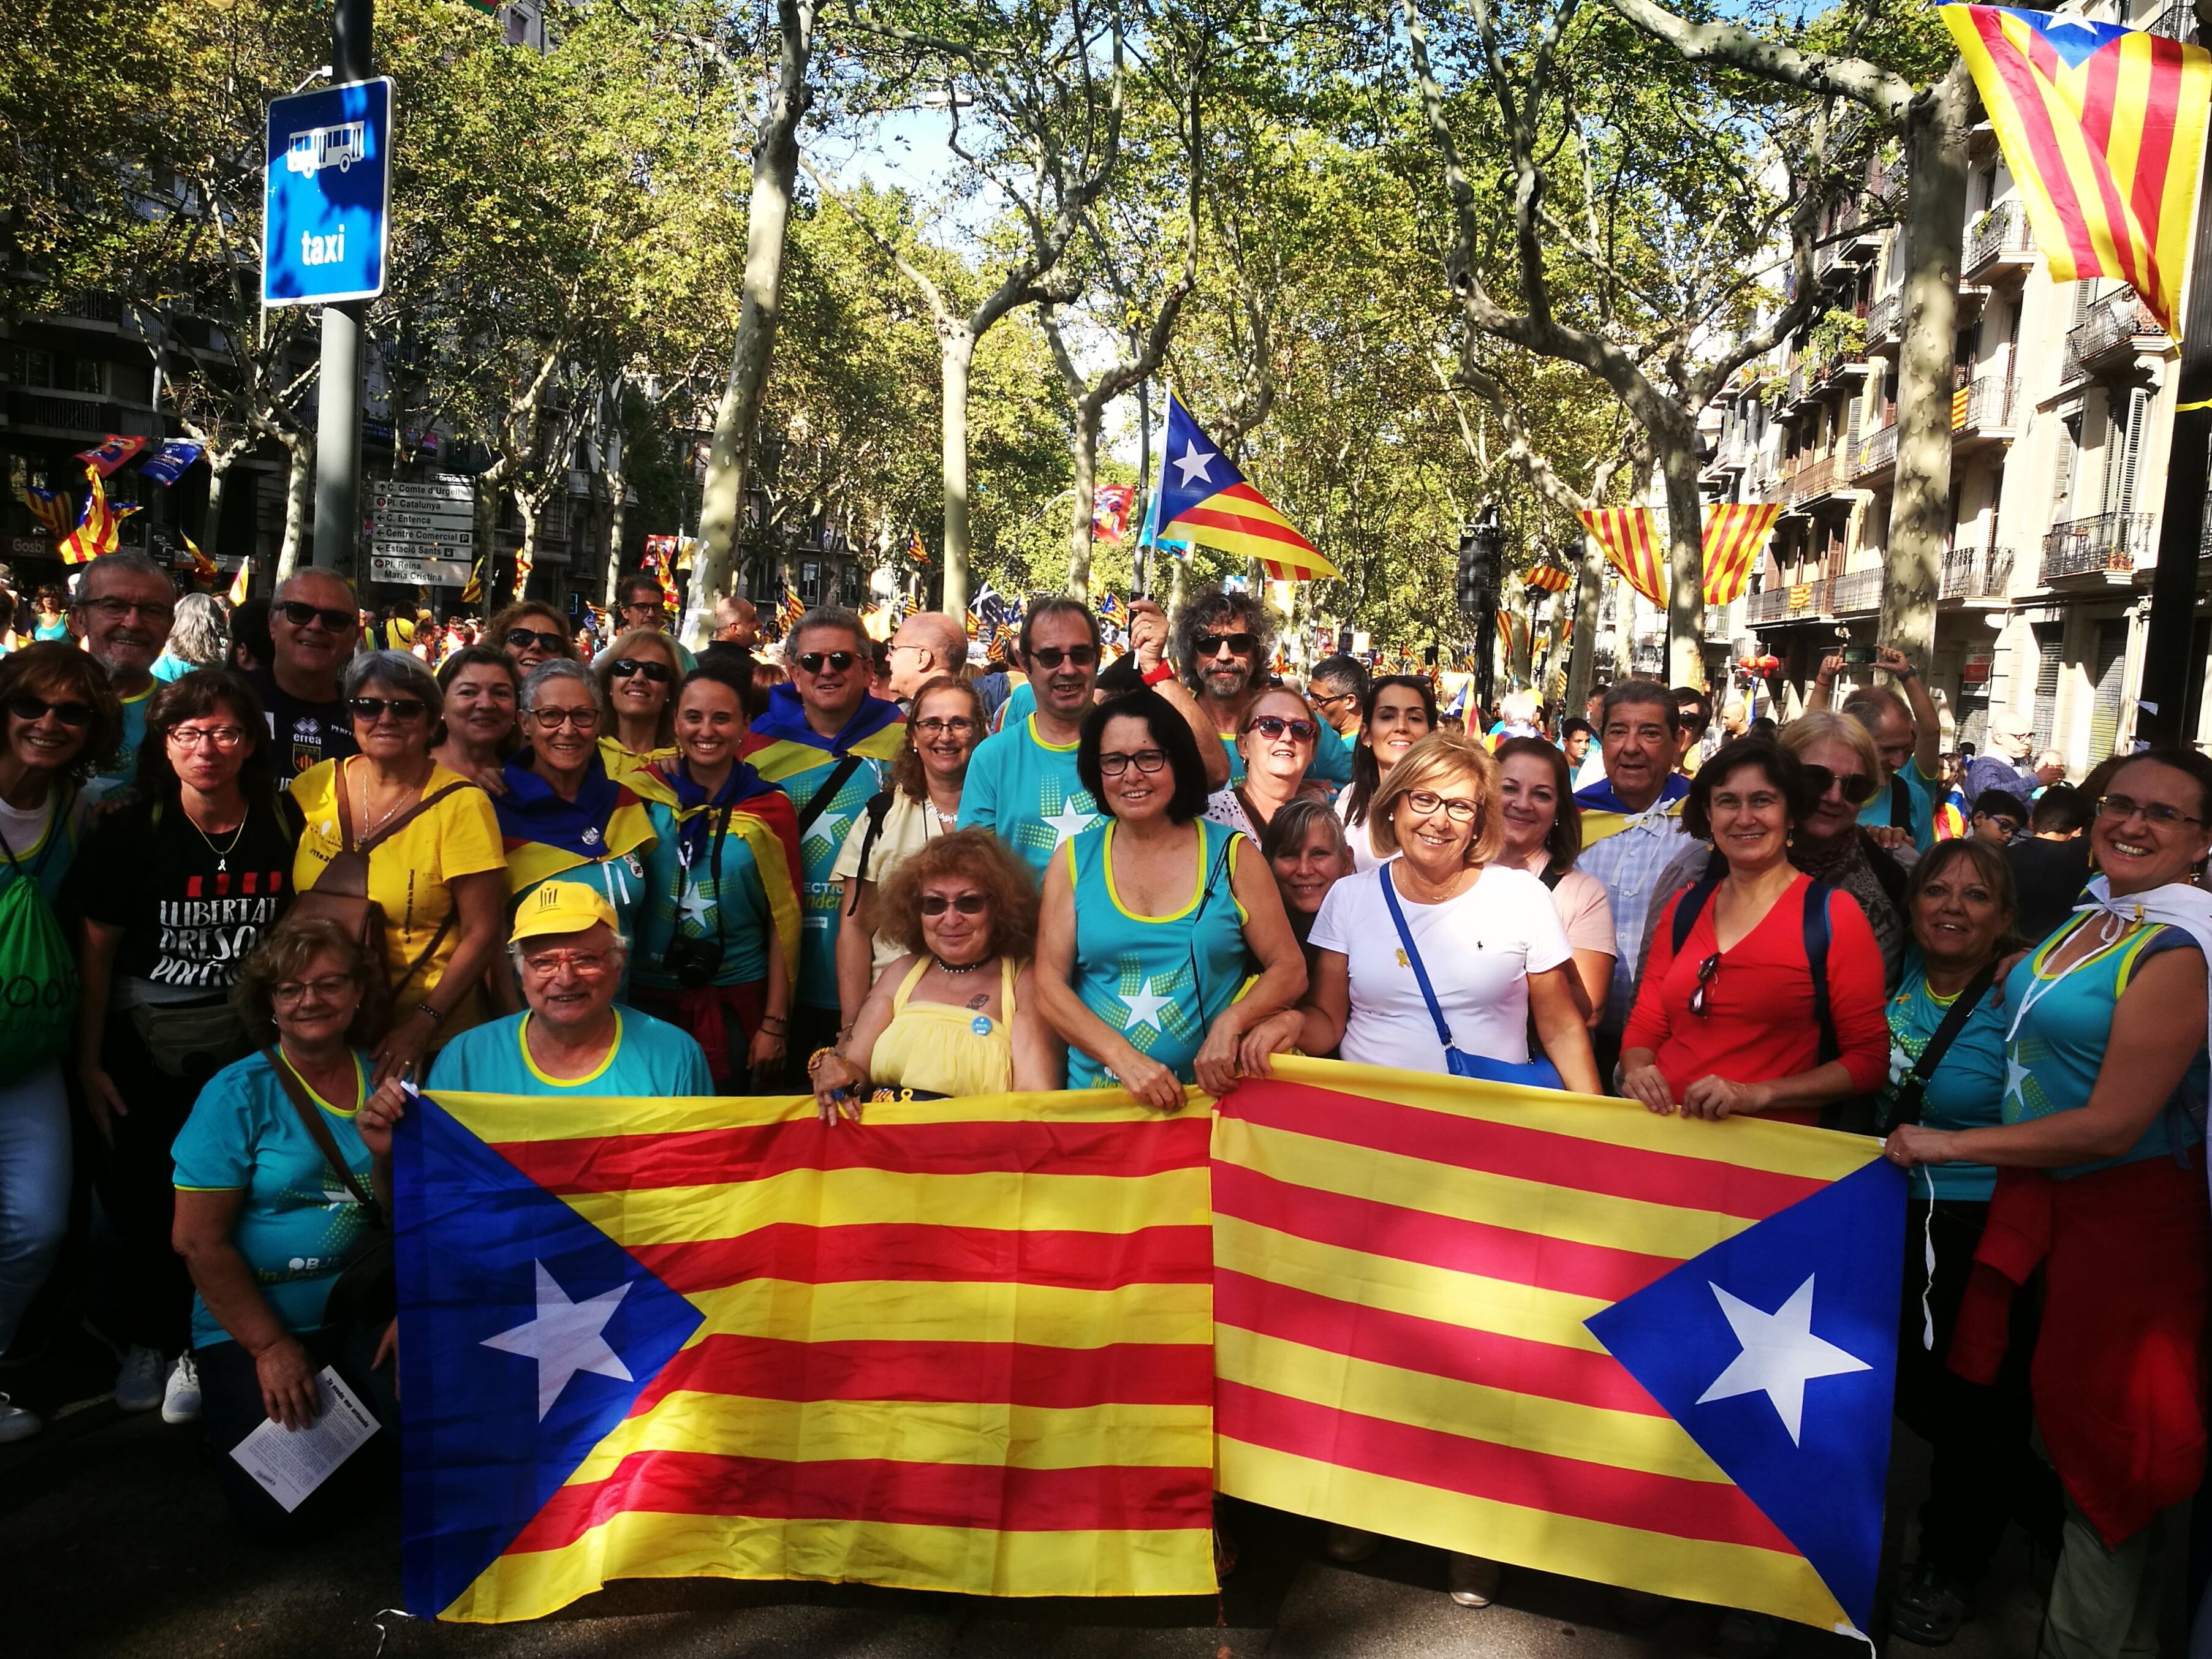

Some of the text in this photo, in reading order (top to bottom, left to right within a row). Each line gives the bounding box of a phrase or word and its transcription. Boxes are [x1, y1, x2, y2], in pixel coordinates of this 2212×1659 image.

[301, 224, 345, 266] taxi
[399, 484, 425, 494] Comte
[428, 487, 460, 497] d'Urgell
[400, 500, 441, 511] Catalunya
[398, 514, 431, 524] Entença
[386, 529, 414, 539] Centre
[416, 531, 458, 541] Comercial
[13, 539, 45, 554] Gosbi
[385, 544, 442, 555] Estació Sants
[385, 560, 395, 569] Pl.
[384, 571, 442, 582] Maria Cristina
[160, 898, 278, 927] LLIBERTAT
